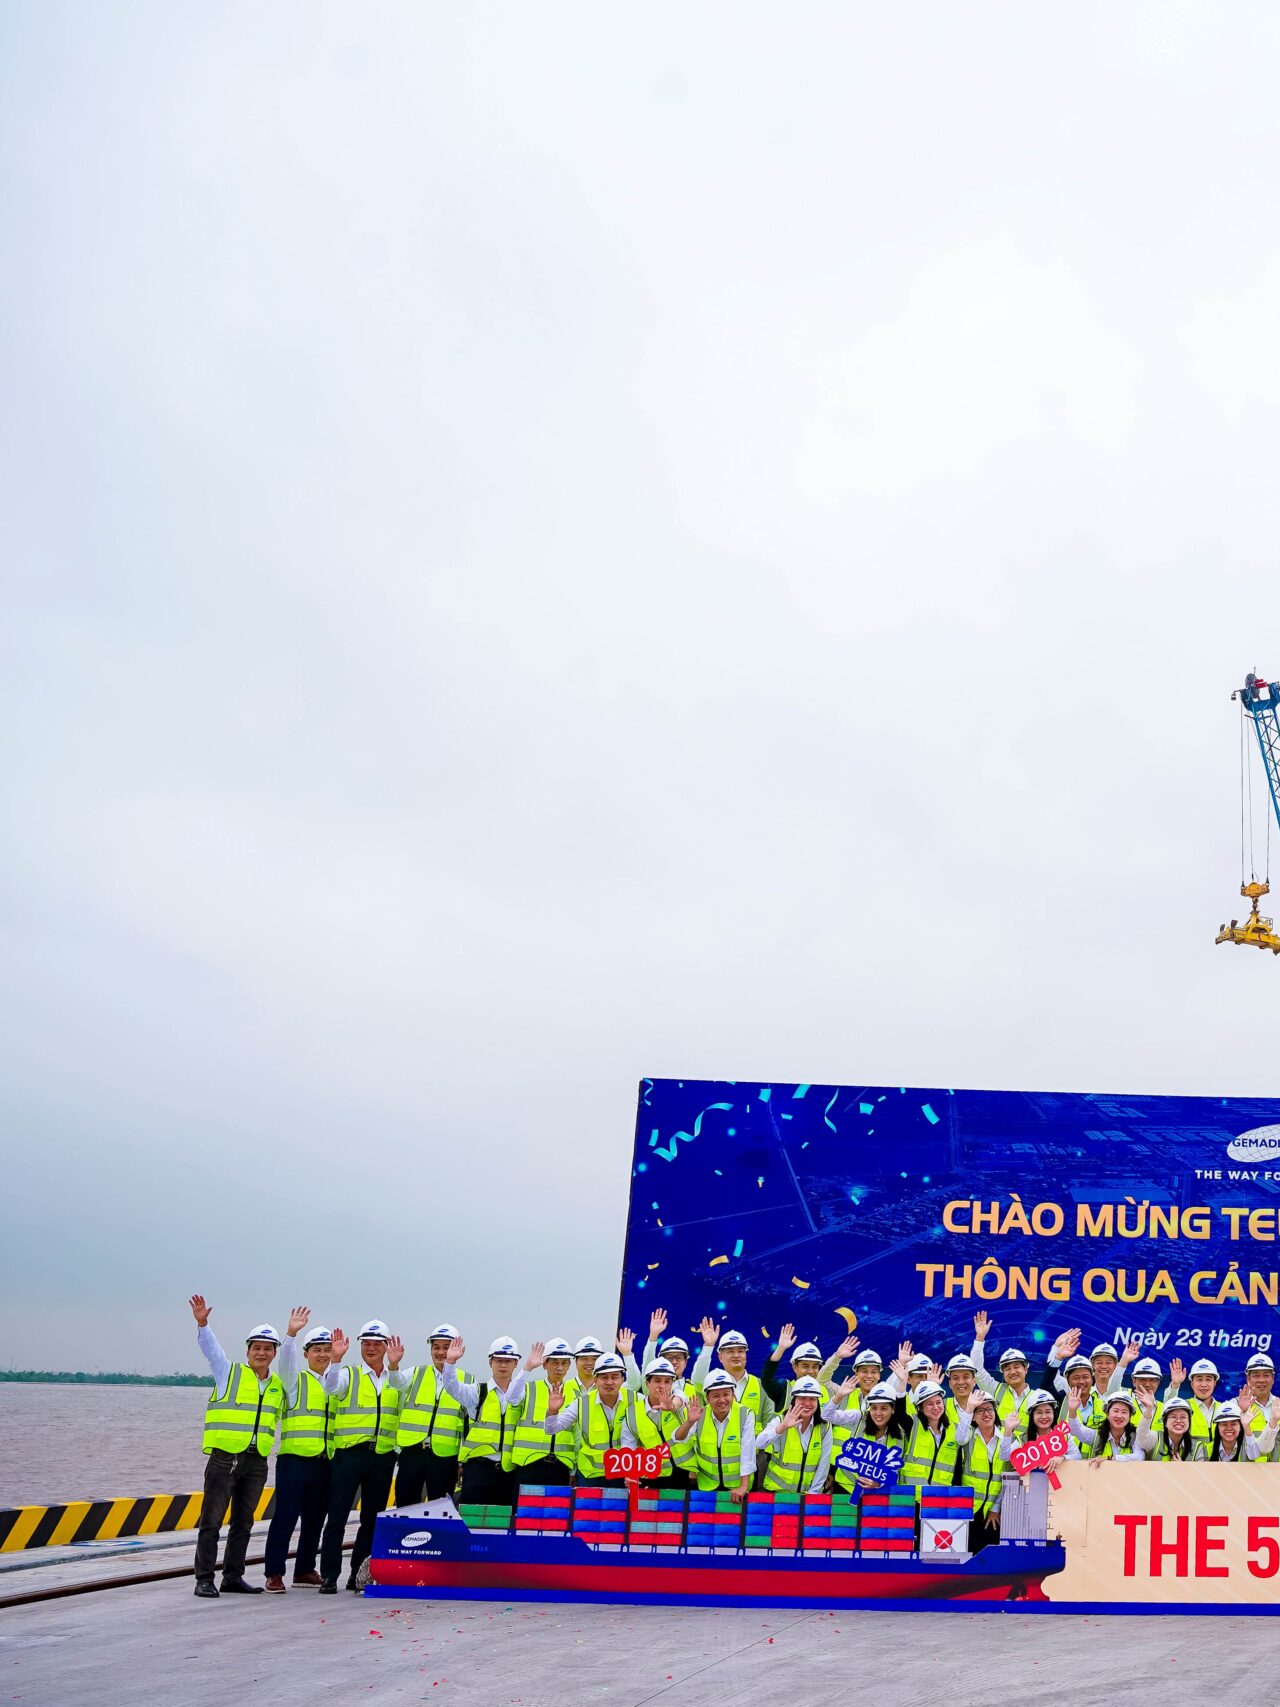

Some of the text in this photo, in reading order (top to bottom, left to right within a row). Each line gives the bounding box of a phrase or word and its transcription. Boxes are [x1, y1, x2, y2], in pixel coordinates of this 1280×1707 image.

[1195, 1169, 1222, 1180] THE
[1228, 1170, 1259, 1181] WAY
[942, 1193, 1064, 1236] CHÀO
[1076, 1196, 1211, 1240] MỪNG
[915, 1256, 1071, 1301] THÔNG
[1082, 1268, 1180, 1304] QUA
[1113, 1327, 1171, 1350] Ngày
[1175, 1328, 1203, 1347] 23
[1208, 1329, 1272, 1352] tháng
[608, 1453, 657, 1473] 2018
[845, 1441, 882, 1464] #5M
[1015, 1435, 1063, 1469] 2018
[859, 1461, 888, 1481] TEUs
[1113, 1514, 1229, 1578] THE
